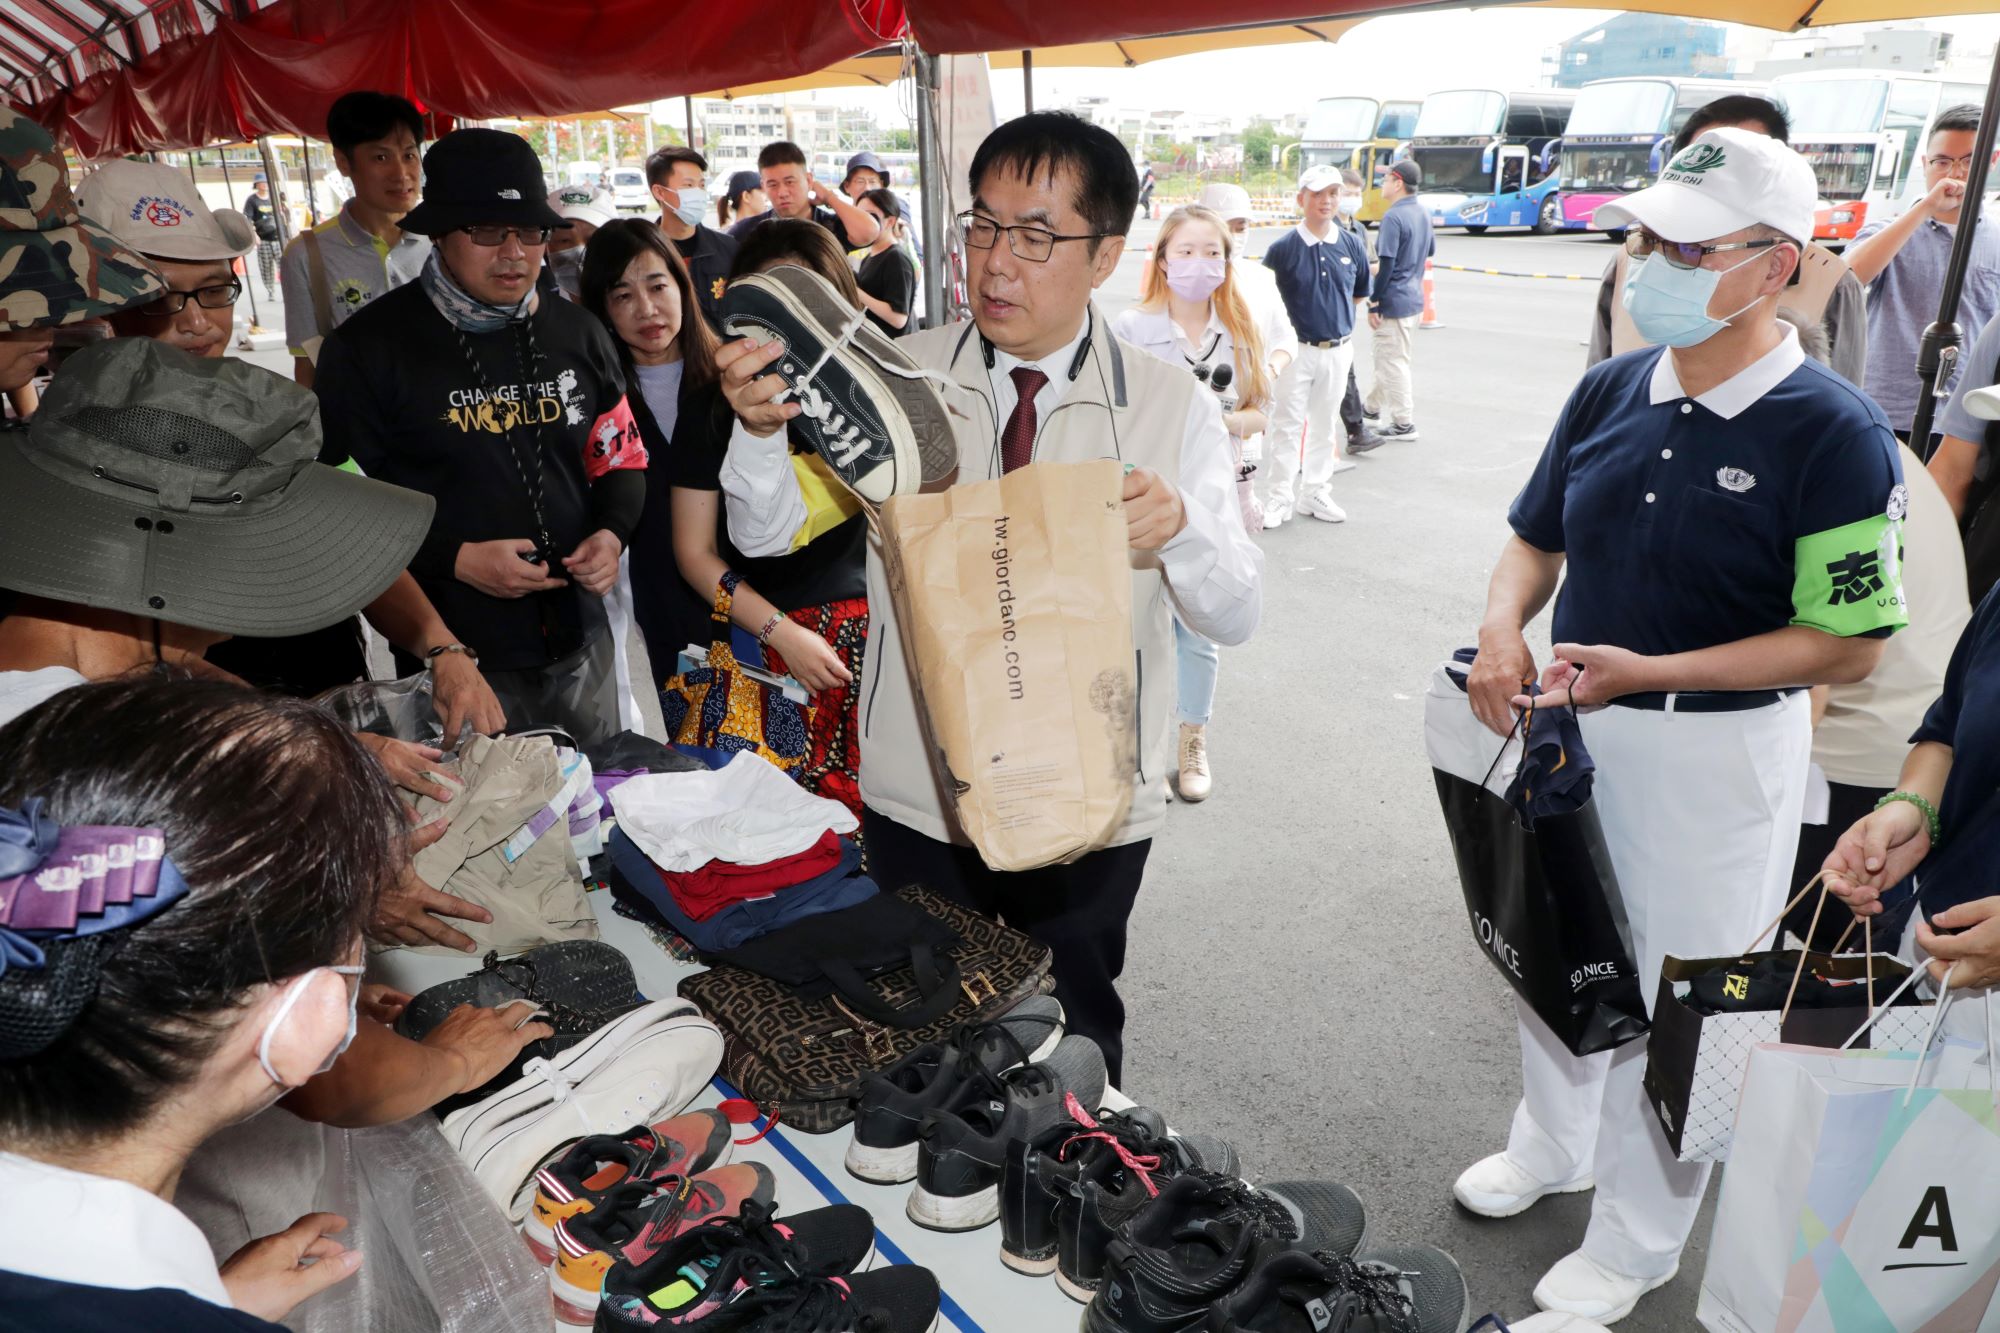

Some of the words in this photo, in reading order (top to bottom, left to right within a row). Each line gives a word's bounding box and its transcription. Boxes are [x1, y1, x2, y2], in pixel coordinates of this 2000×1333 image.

[1682, 175, 1703, 186] CHI
[449, 385, 520, 407] CHANGE
[526, 382, 556, 398] THE
[455, 397, 561, 433] WORLD
[991, 516, 1024, 700] tw.giordano.com
[1475, 911, 1492, 944] SO
[1494, 928, 1523, 979] NICE
[1570, 970, 1582, 987] SO
[1584, 962, 1617, 977] NICE
[1897, 1186, 1959, 1252] A
